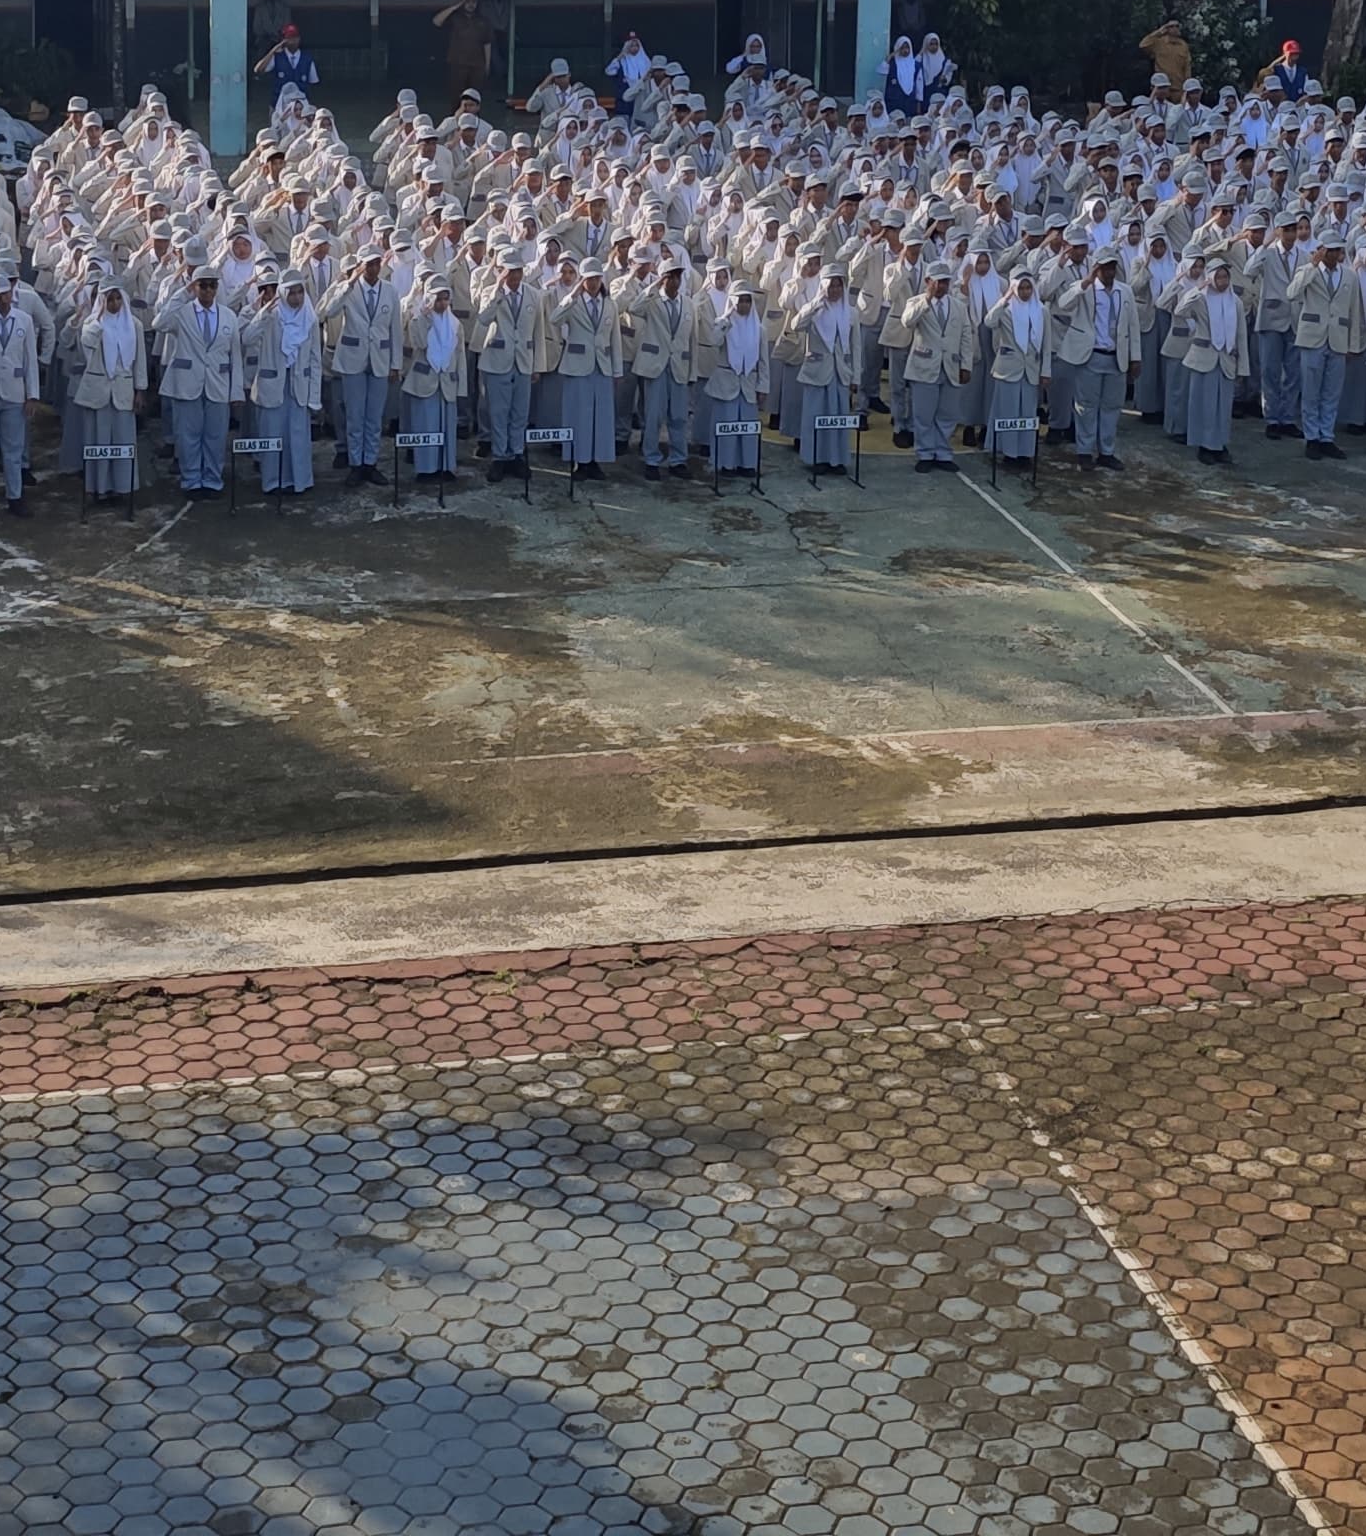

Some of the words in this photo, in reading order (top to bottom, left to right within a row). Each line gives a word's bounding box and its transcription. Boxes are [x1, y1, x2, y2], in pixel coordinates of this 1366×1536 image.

[818, 417, 839, 426] KELAS
[998, 420, 1017, 429] KELAS
[1019, 420, 1026, 428] XI
[719, 424, 739, 433] KELAS
[741, 424, 747, 433] XI
[399, 435, 420, 444] KELAS
[422, 435, 429, 444] XI
[529, 430, 550, 440] KELAS
[552, 430, 559, 439] XI
[235, 441, 256, 450] KELAS
[259, 440, 269, 449] XII
[86, 448, 108, 457] KELAS
[110, 447, 121, 457] XII
